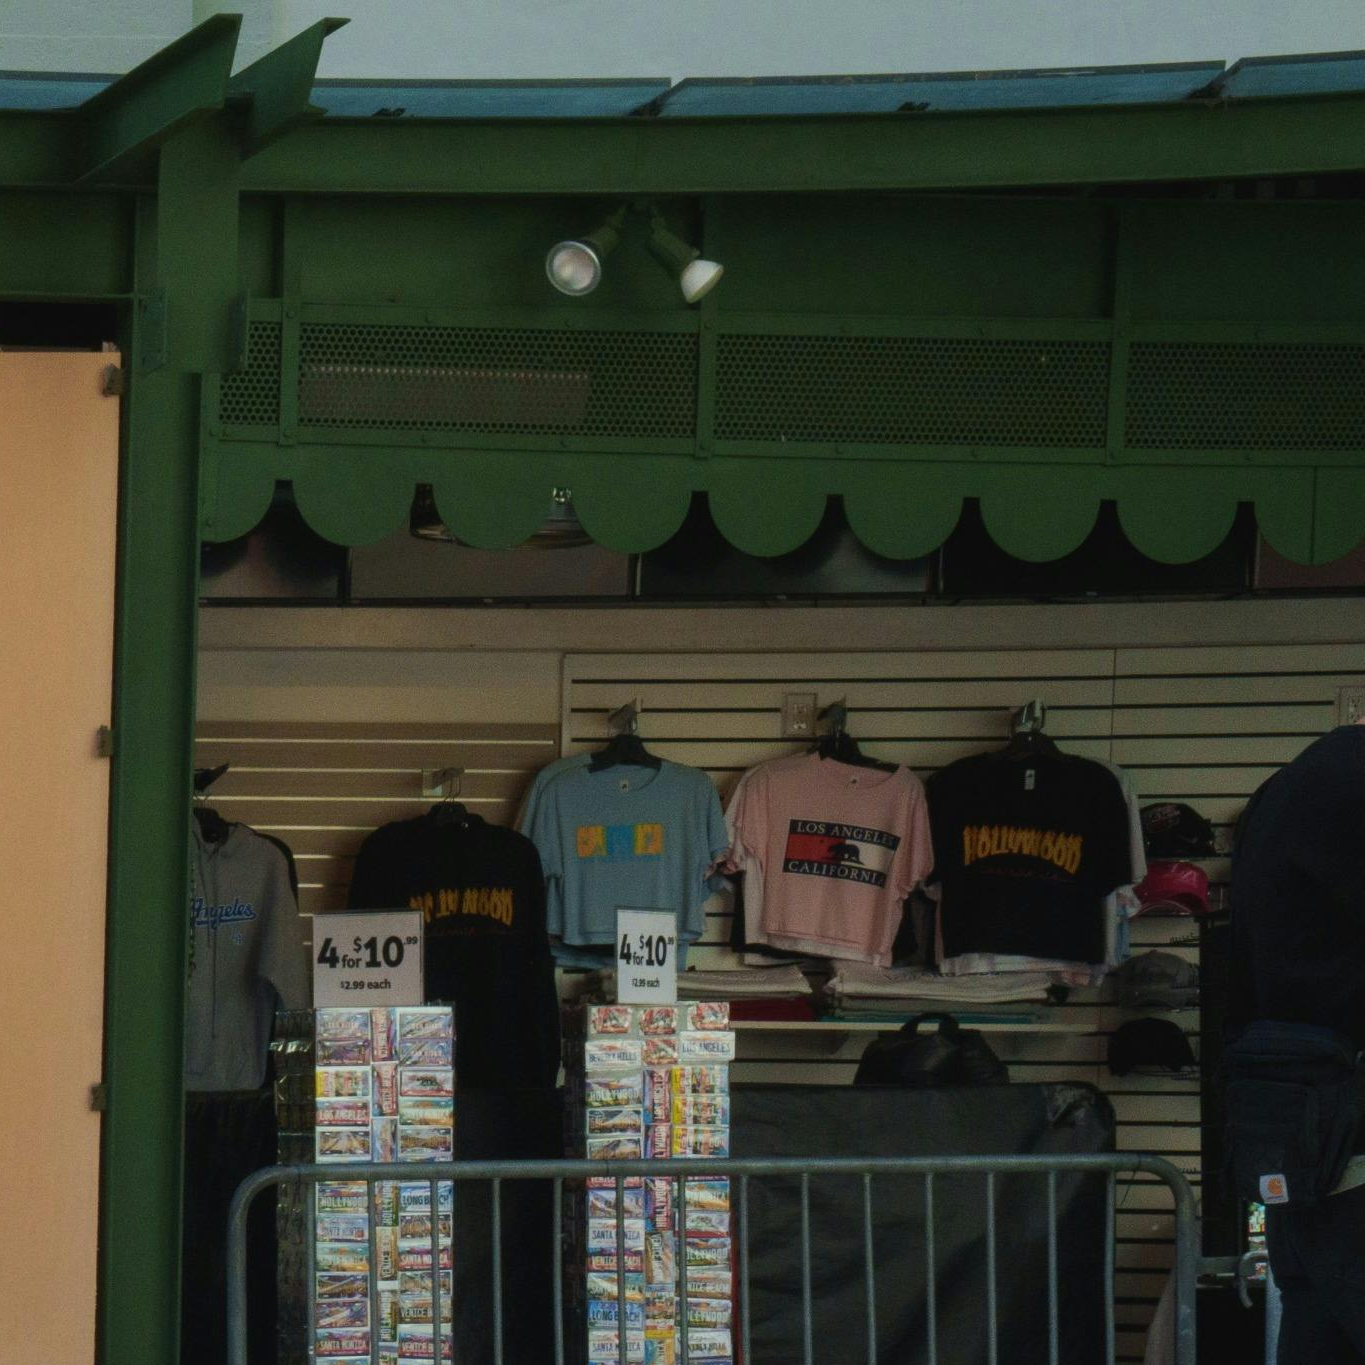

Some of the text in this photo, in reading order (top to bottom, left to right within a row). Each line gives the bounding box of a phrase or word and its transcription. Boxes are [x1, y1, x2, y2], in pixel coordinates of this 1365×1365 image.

[797, 821, 826, 833] LOS
[963, 825, 1083, 874] HOLLYWOOD
[317, 938, 340, 968] 4
[341, 954, 362, 968] for
[619, 934, 632, 965] 4
[633, 952, 644, 966] for
[367, 979, 391, 989] each
